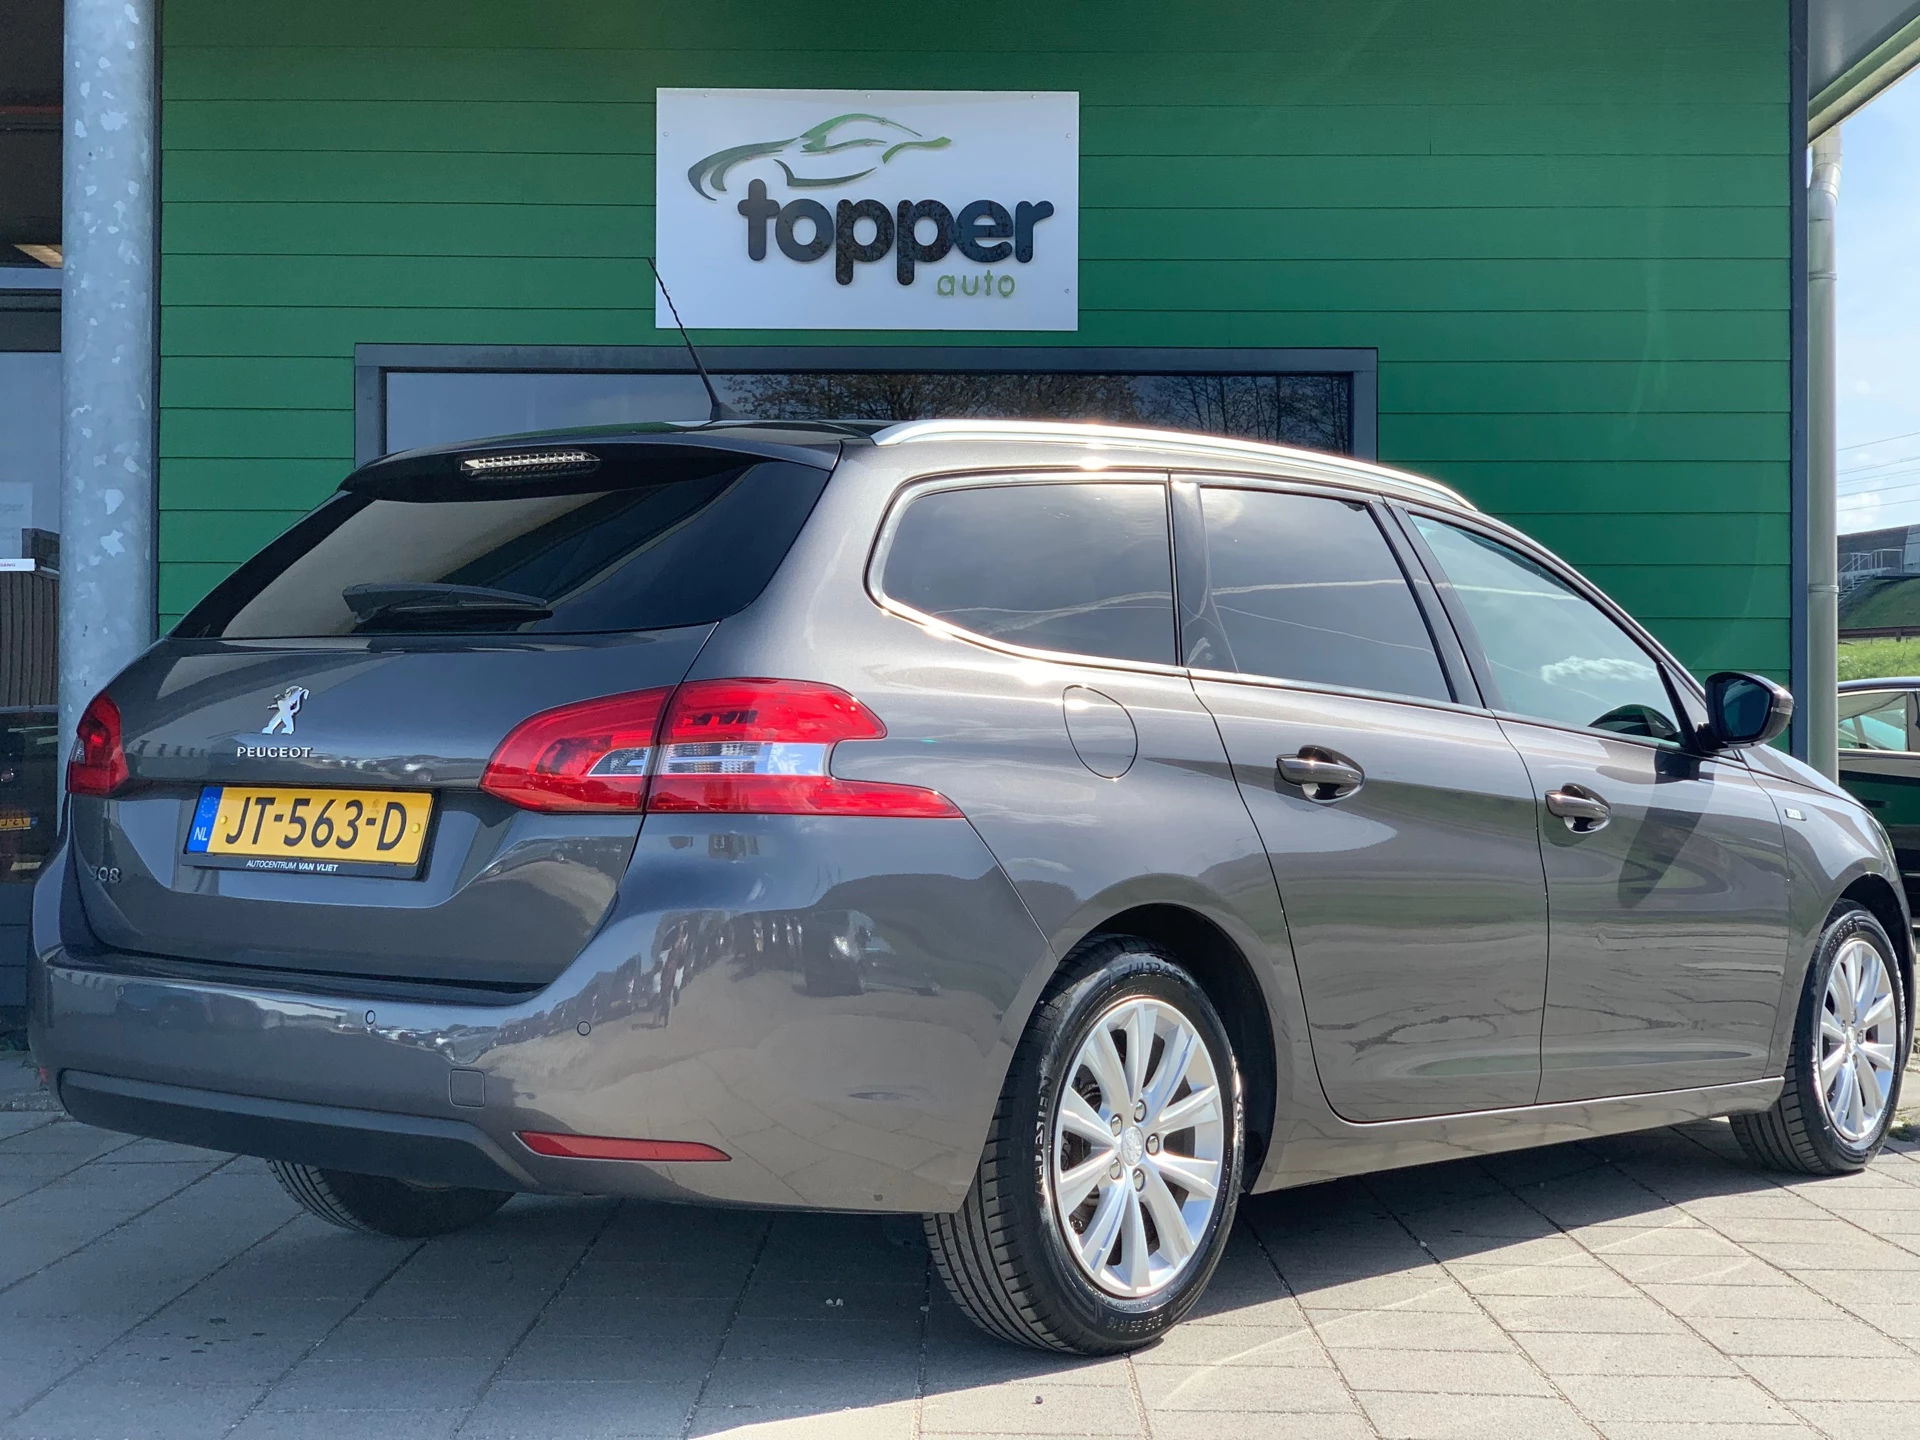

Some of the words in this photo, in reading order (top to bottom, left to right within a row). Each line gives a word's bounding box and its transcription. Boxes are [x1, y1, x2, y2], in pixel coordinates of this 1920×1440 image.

[737, 178, 1055, 286] topper
[937, 269, 1016, 297] auto
[236, 746, 312, 759] PEUGEOT
[193, 826, 208, 841] NL
[225, 796, 407, 851] JT-563-D
[245, 860, 297, 870] AUTOCENTRUM
[298, 862, 315, 871] VAN
[316, 863, 339, 873] VLIET
